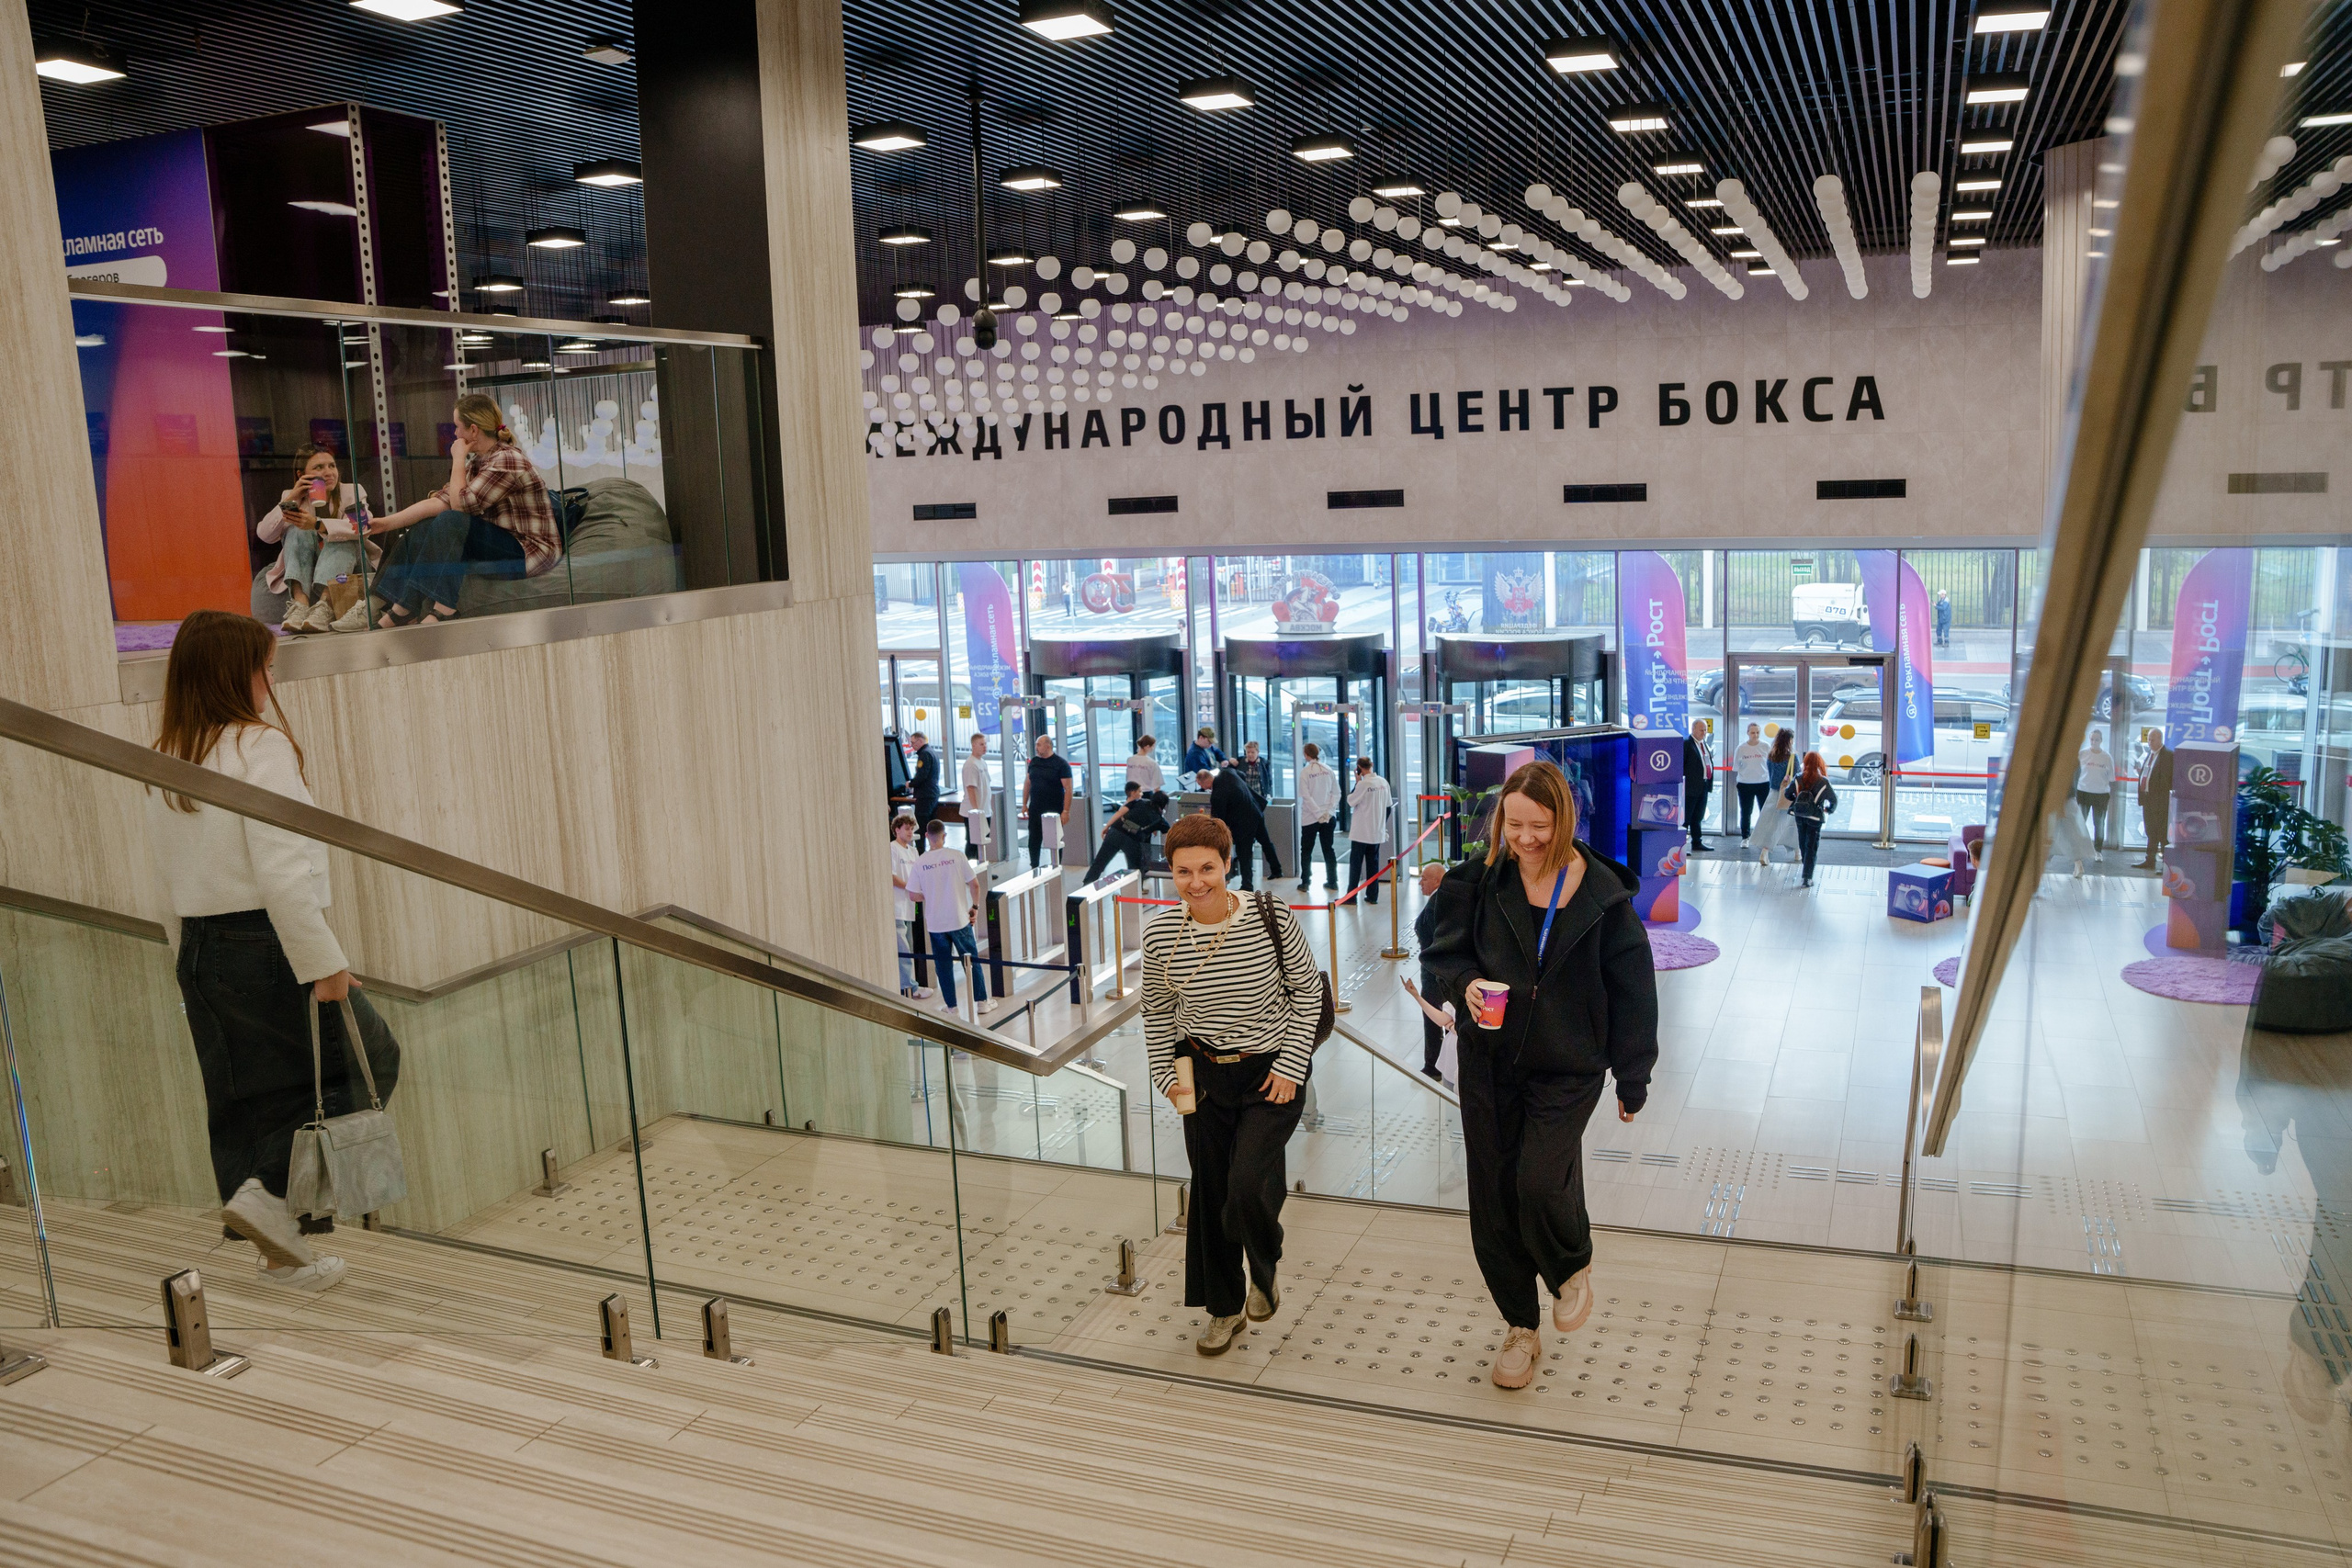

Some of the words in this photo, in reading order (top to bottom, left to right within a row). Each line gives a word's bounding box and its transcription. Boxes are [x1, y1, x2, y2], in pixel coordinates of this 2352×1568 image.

[63, 231, 126, 256] ламная
[128, 227, 164, 248] сеть
[1410, 386, 1619, 440] ЦЕНТР
[1658, 376, 1885, 426] БОКСА
[987, 604, 995, 624] сеть
[1645, 598, 1665, 648] Рост
[1825, 606, 1847, 615] 878
[1901, 627, 1913, 689] Рекламная
[1649, 661, 1668, 713] Пост
[2165, 722, 2206, 739] 7-23
